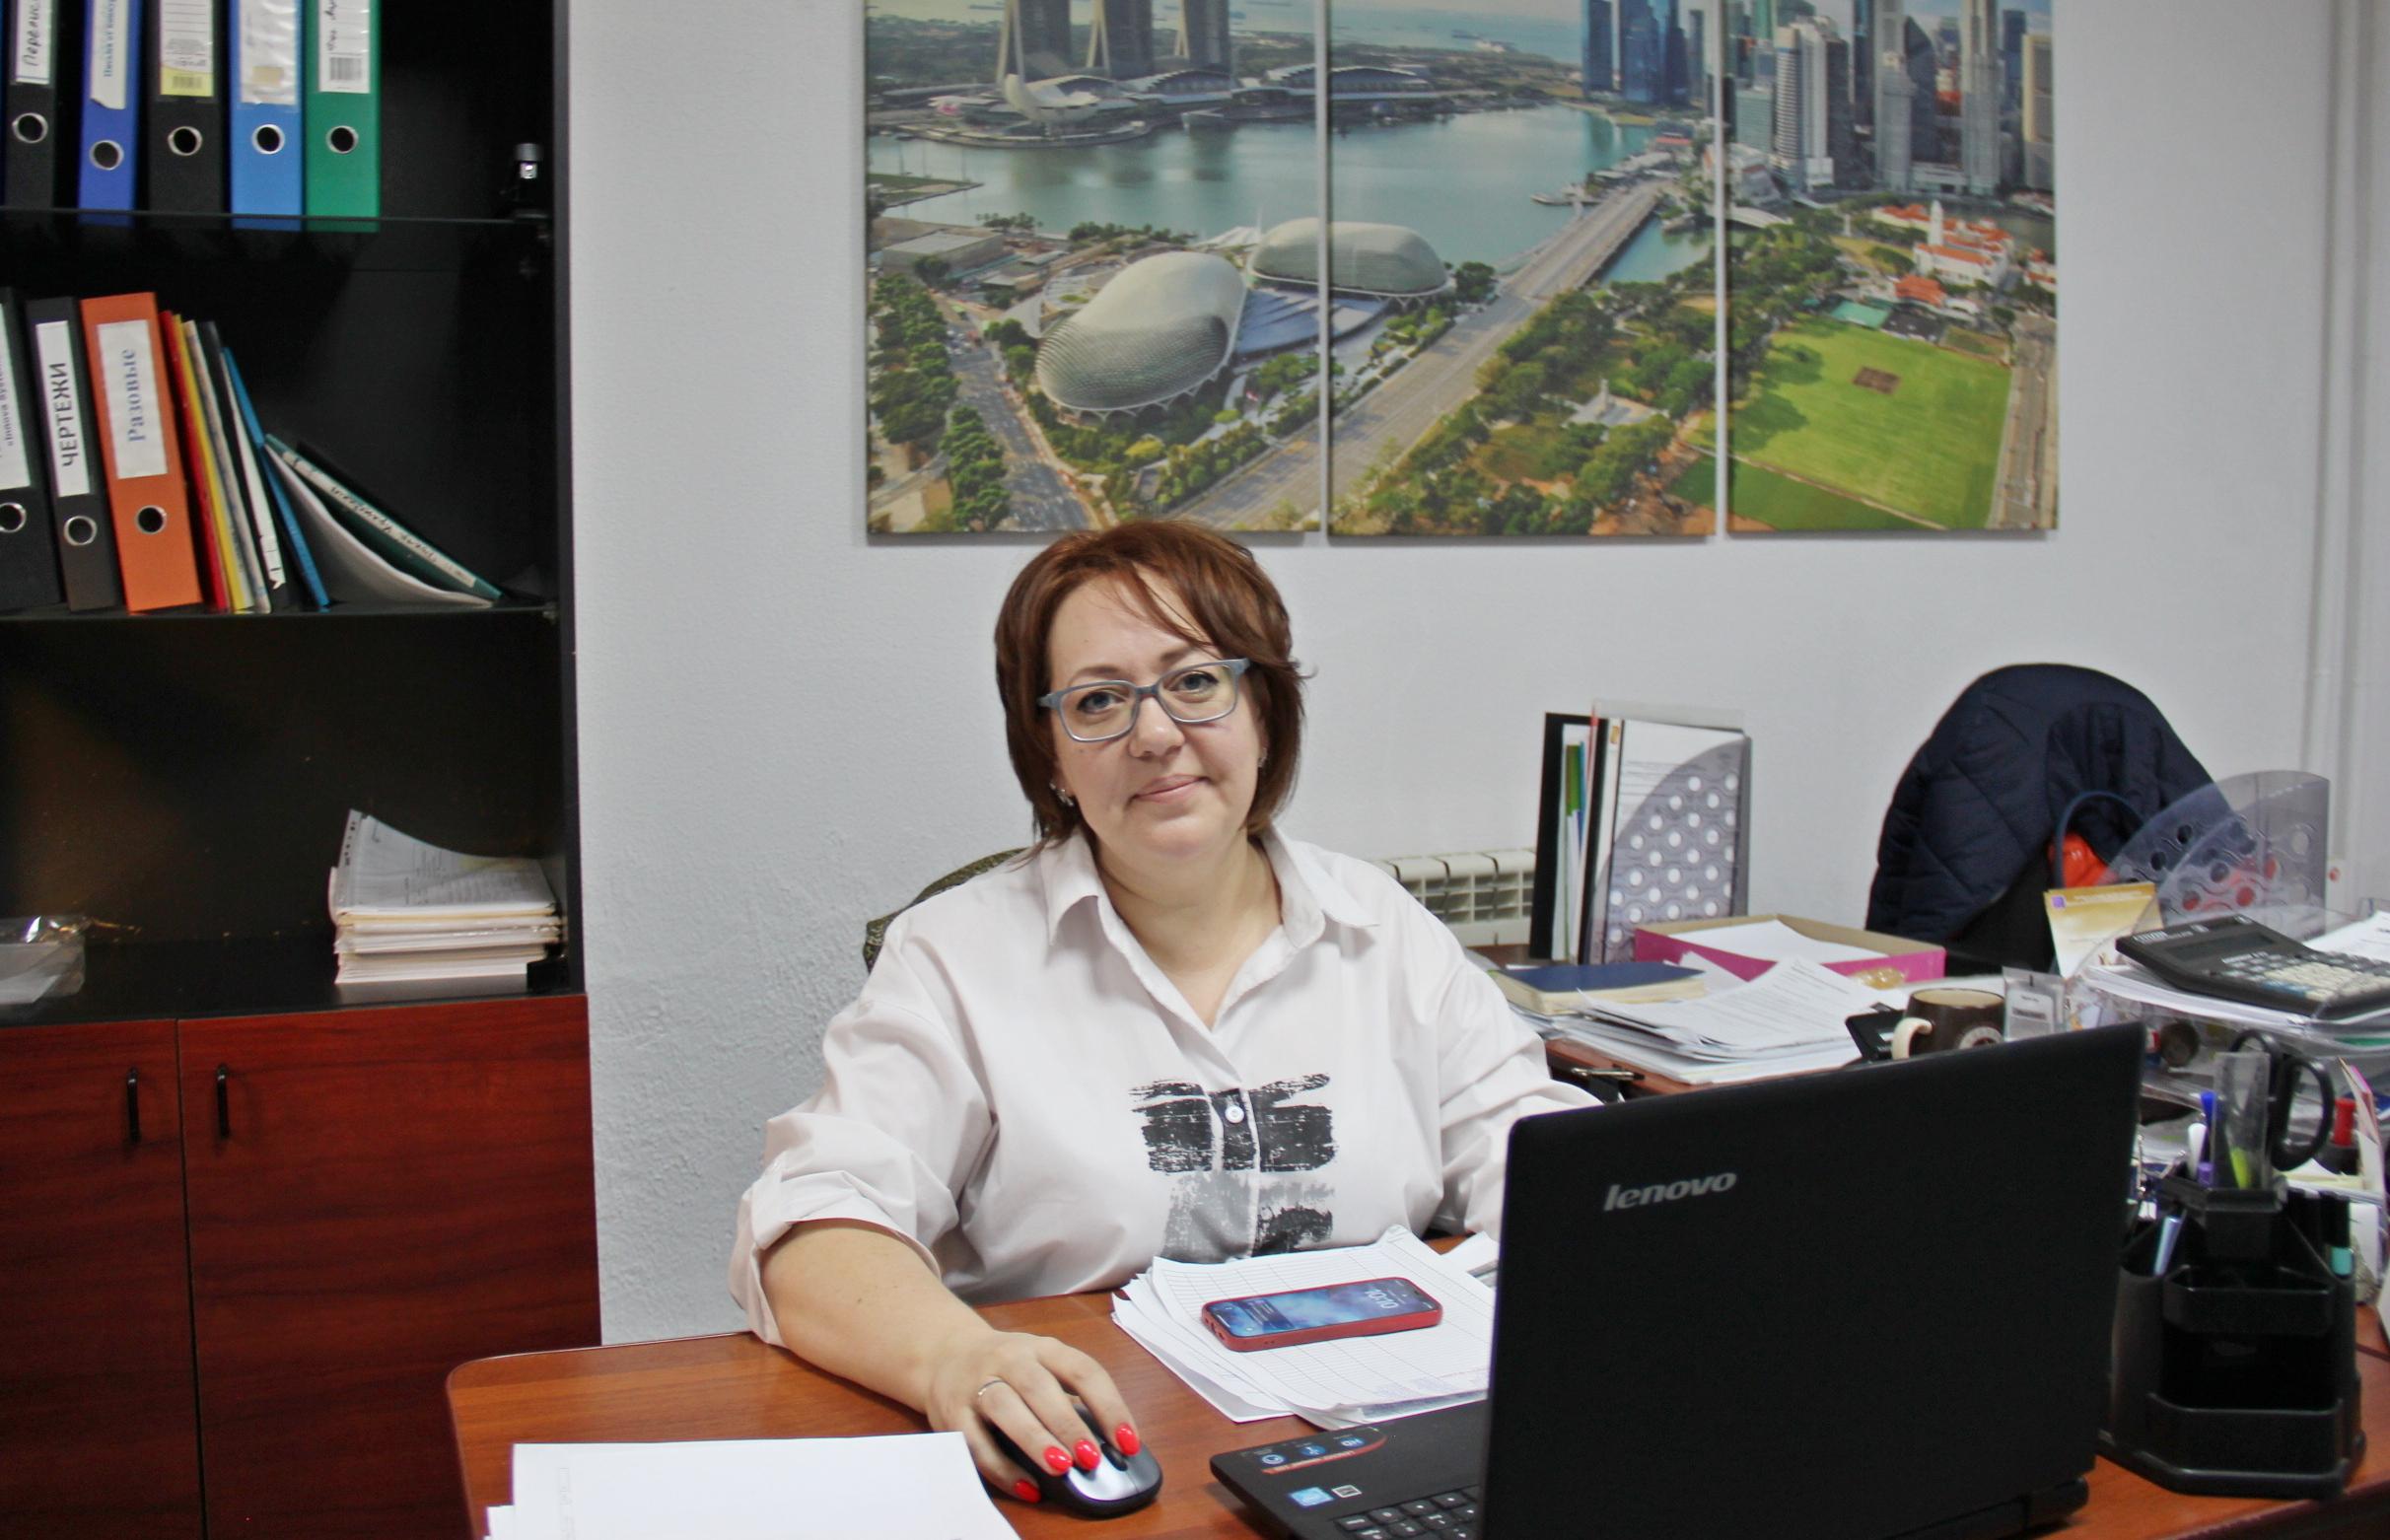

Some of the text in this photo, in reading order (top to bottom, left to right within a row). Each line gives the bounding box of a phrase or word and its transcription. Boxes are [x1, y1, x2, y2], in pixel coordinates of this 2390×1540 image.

[23, 0, 41, 66] Перепис
[48, 362, 79, 467] ЧЕРТЕЖИ
[122, 348, 146, 442] Разовые
[1603, 1172, 1737, 1211] lenovo
